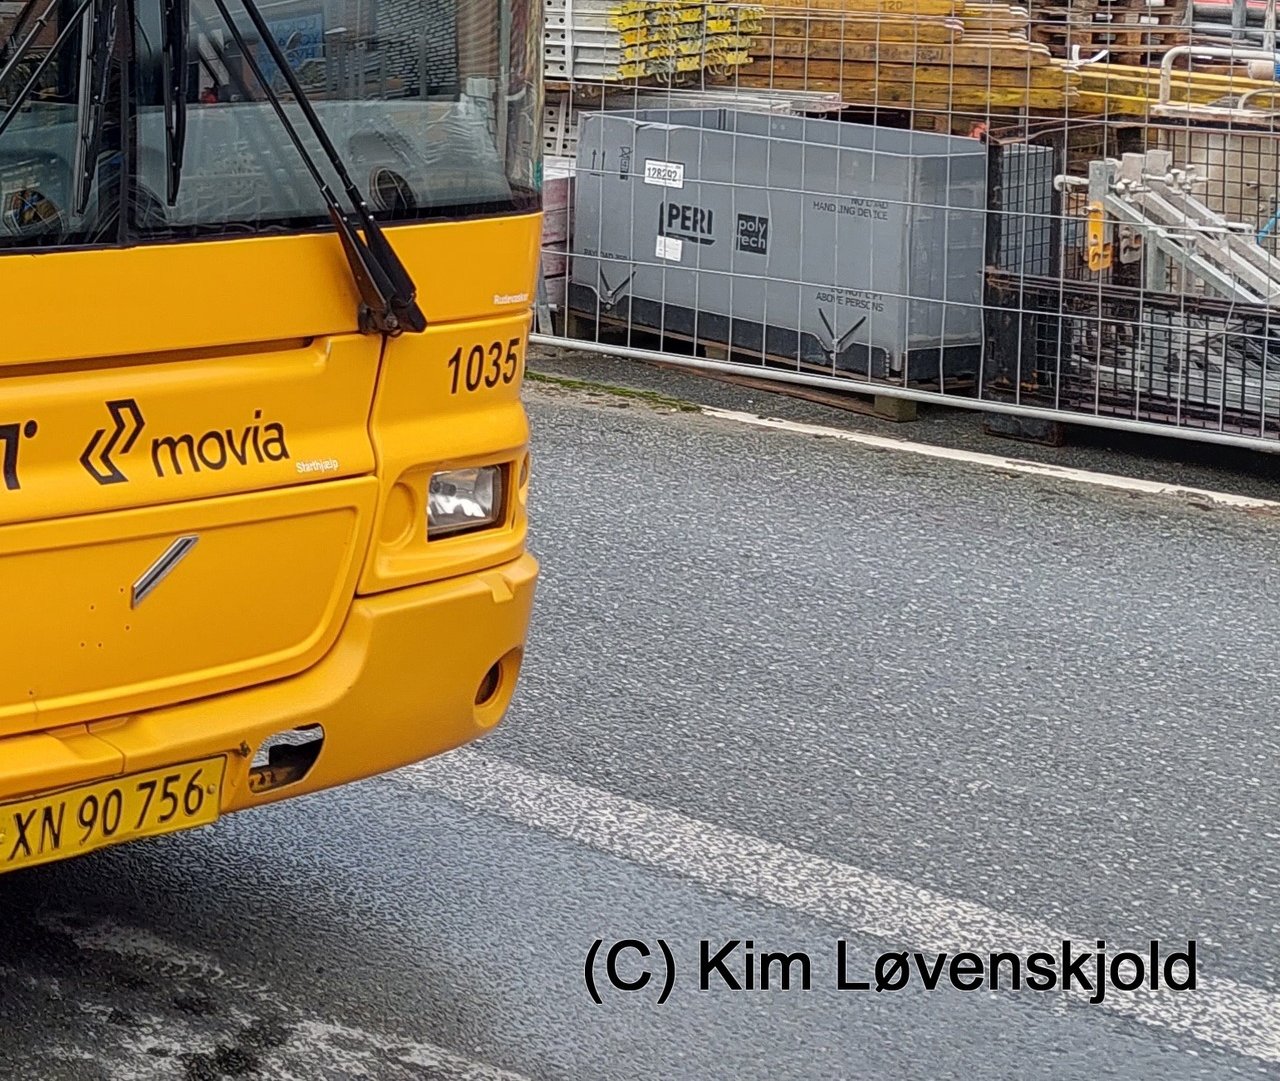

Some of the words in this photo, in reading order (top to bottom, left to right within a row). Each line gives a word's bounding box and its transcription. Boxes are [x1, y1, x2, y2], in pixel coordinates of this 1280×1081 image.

[667, 201, 714, 236] PERI
[738, 215, 767, 238] poly
[447, 337, 521, 395] 1035
[151, 409, 291, 478] movia
[6, 801, 66, 862] XN
[77, 787, 123, 845] 90
[136, 768, 204, 830] 756
